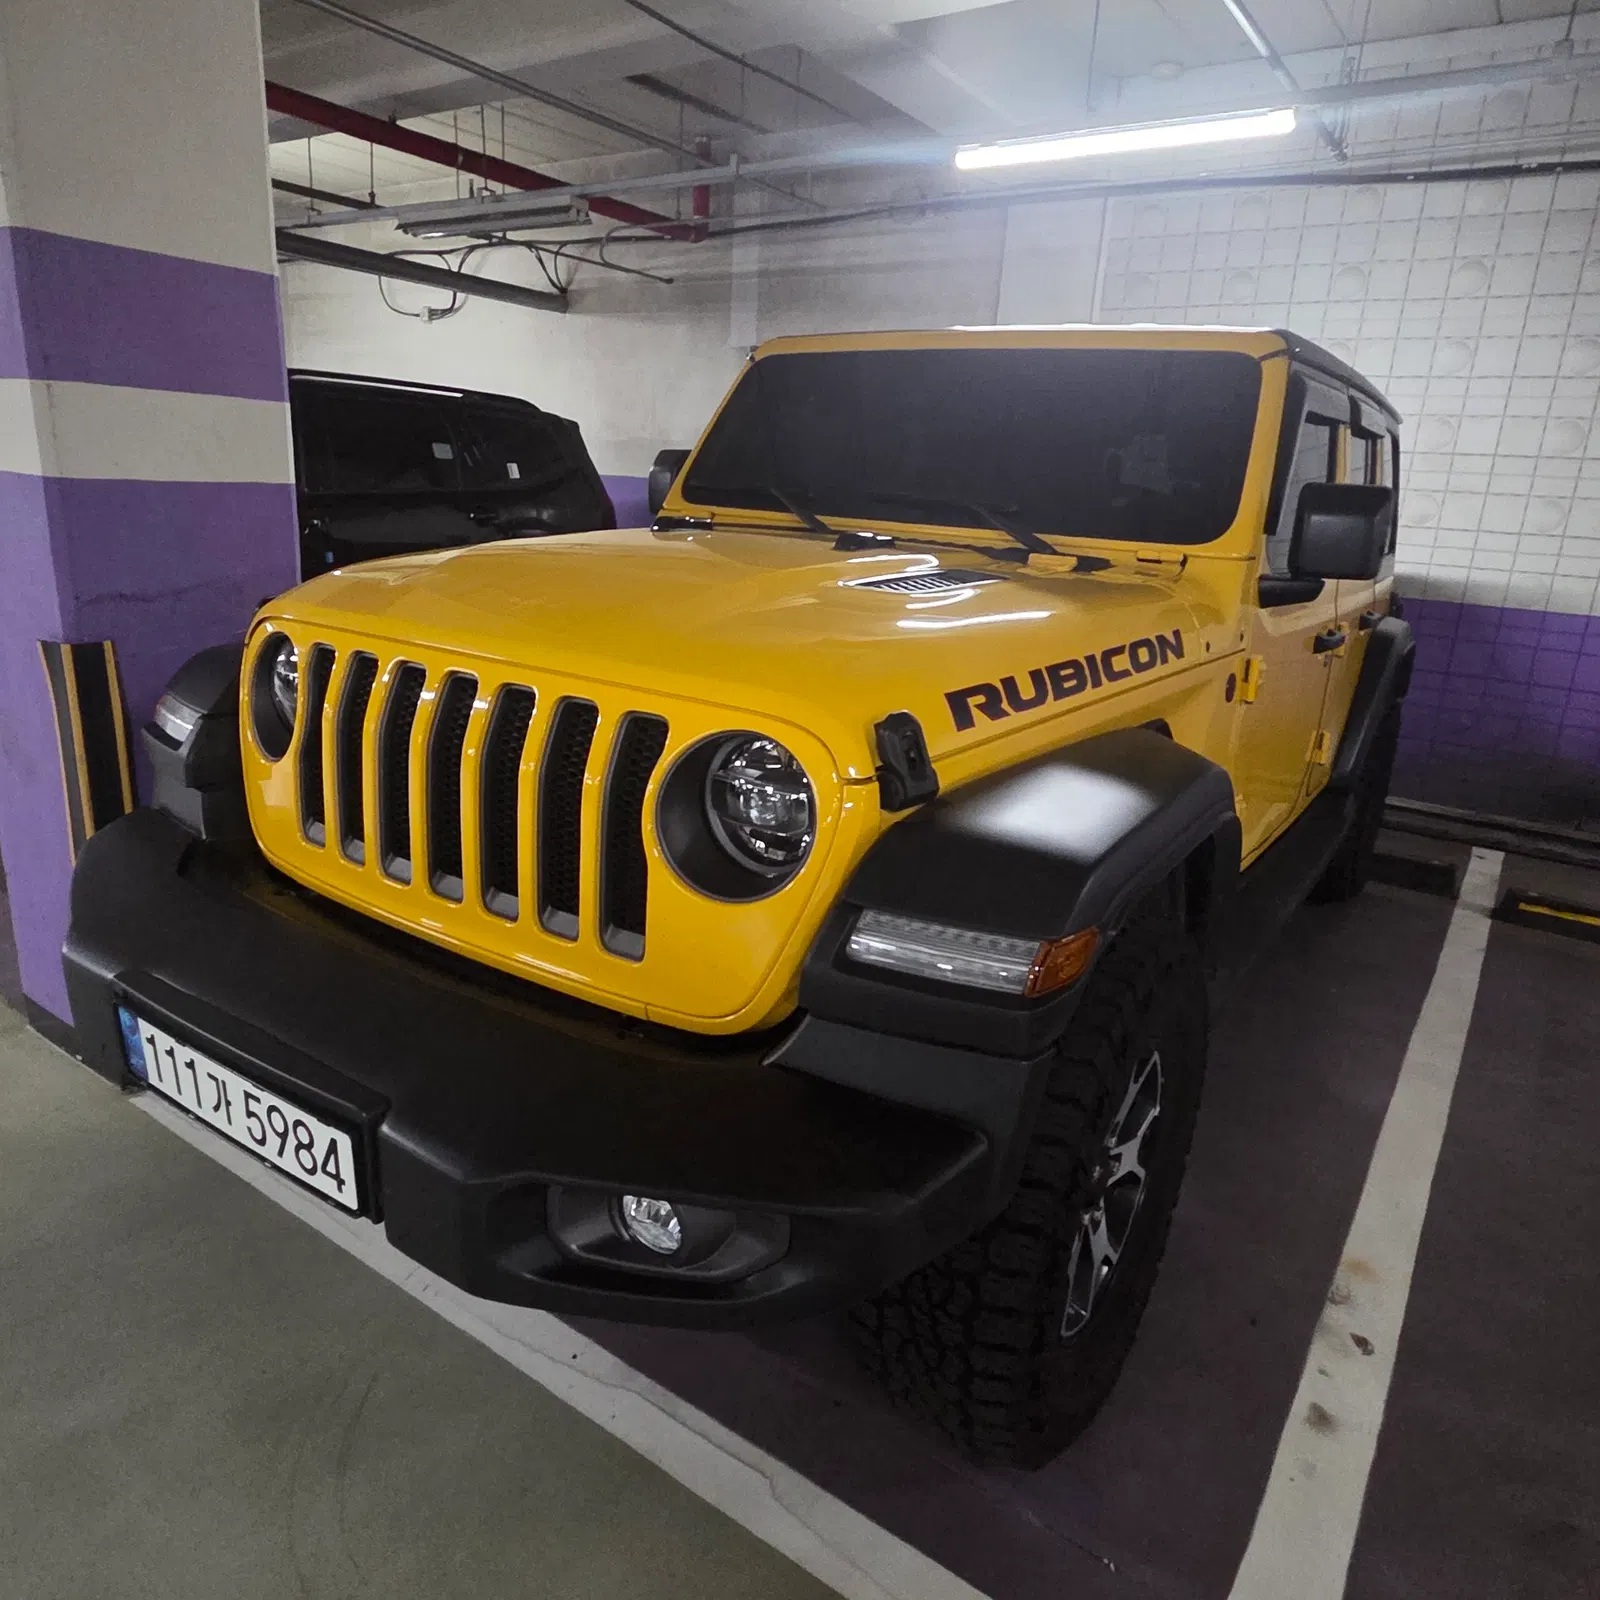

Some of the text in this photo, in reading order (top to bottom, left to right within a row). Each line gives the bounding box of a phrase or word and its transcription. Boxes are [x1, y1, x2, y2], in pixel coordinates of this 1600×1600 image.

[944, 629, 1185, 732] RUBICON
[145, 1033, 346, 1193] 111가 5984
